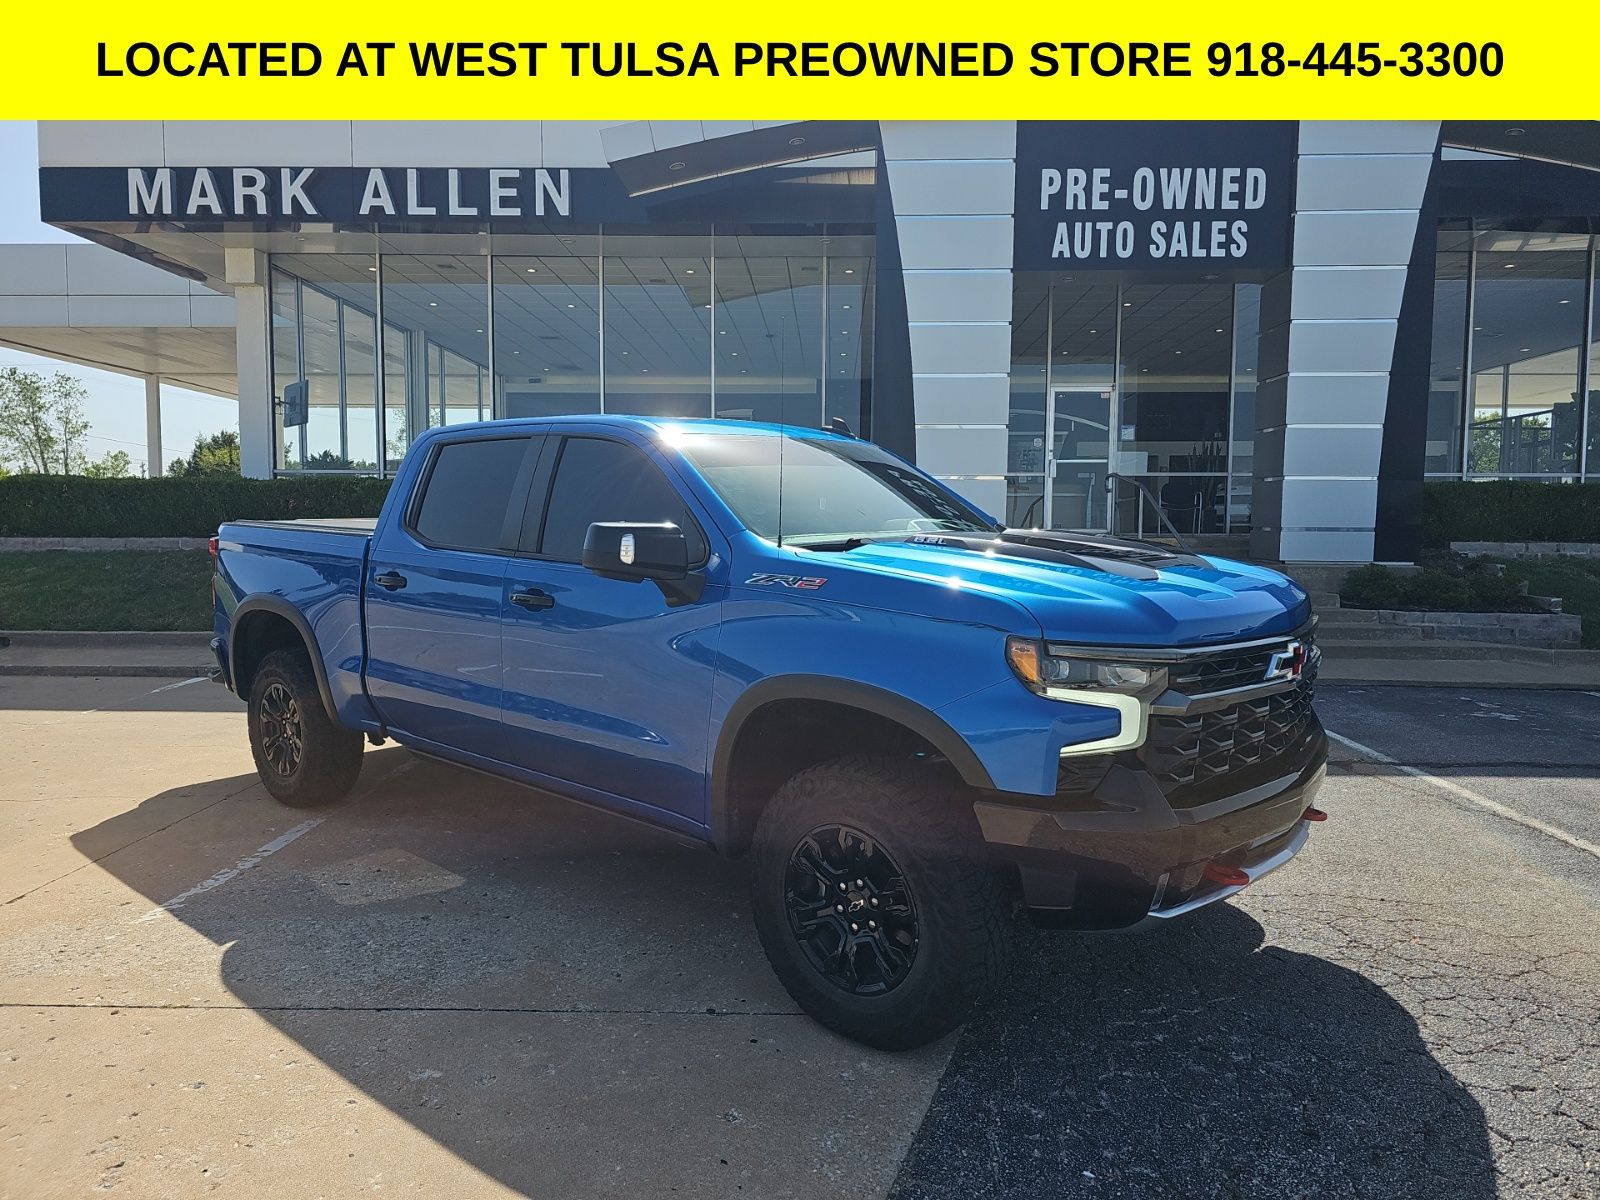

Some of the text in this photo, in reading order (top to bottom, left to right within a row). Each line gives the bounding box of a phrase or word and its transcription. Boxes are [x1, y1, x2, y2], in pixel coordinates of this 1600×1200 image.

[127, 168, 572, 217] MARK ALLEN
[1040, 167, 1267, 211] PRE-OWNED
[1051, 219, 1249, 259] AUTO SALES
[744, 572, 828, 590] ZR2
